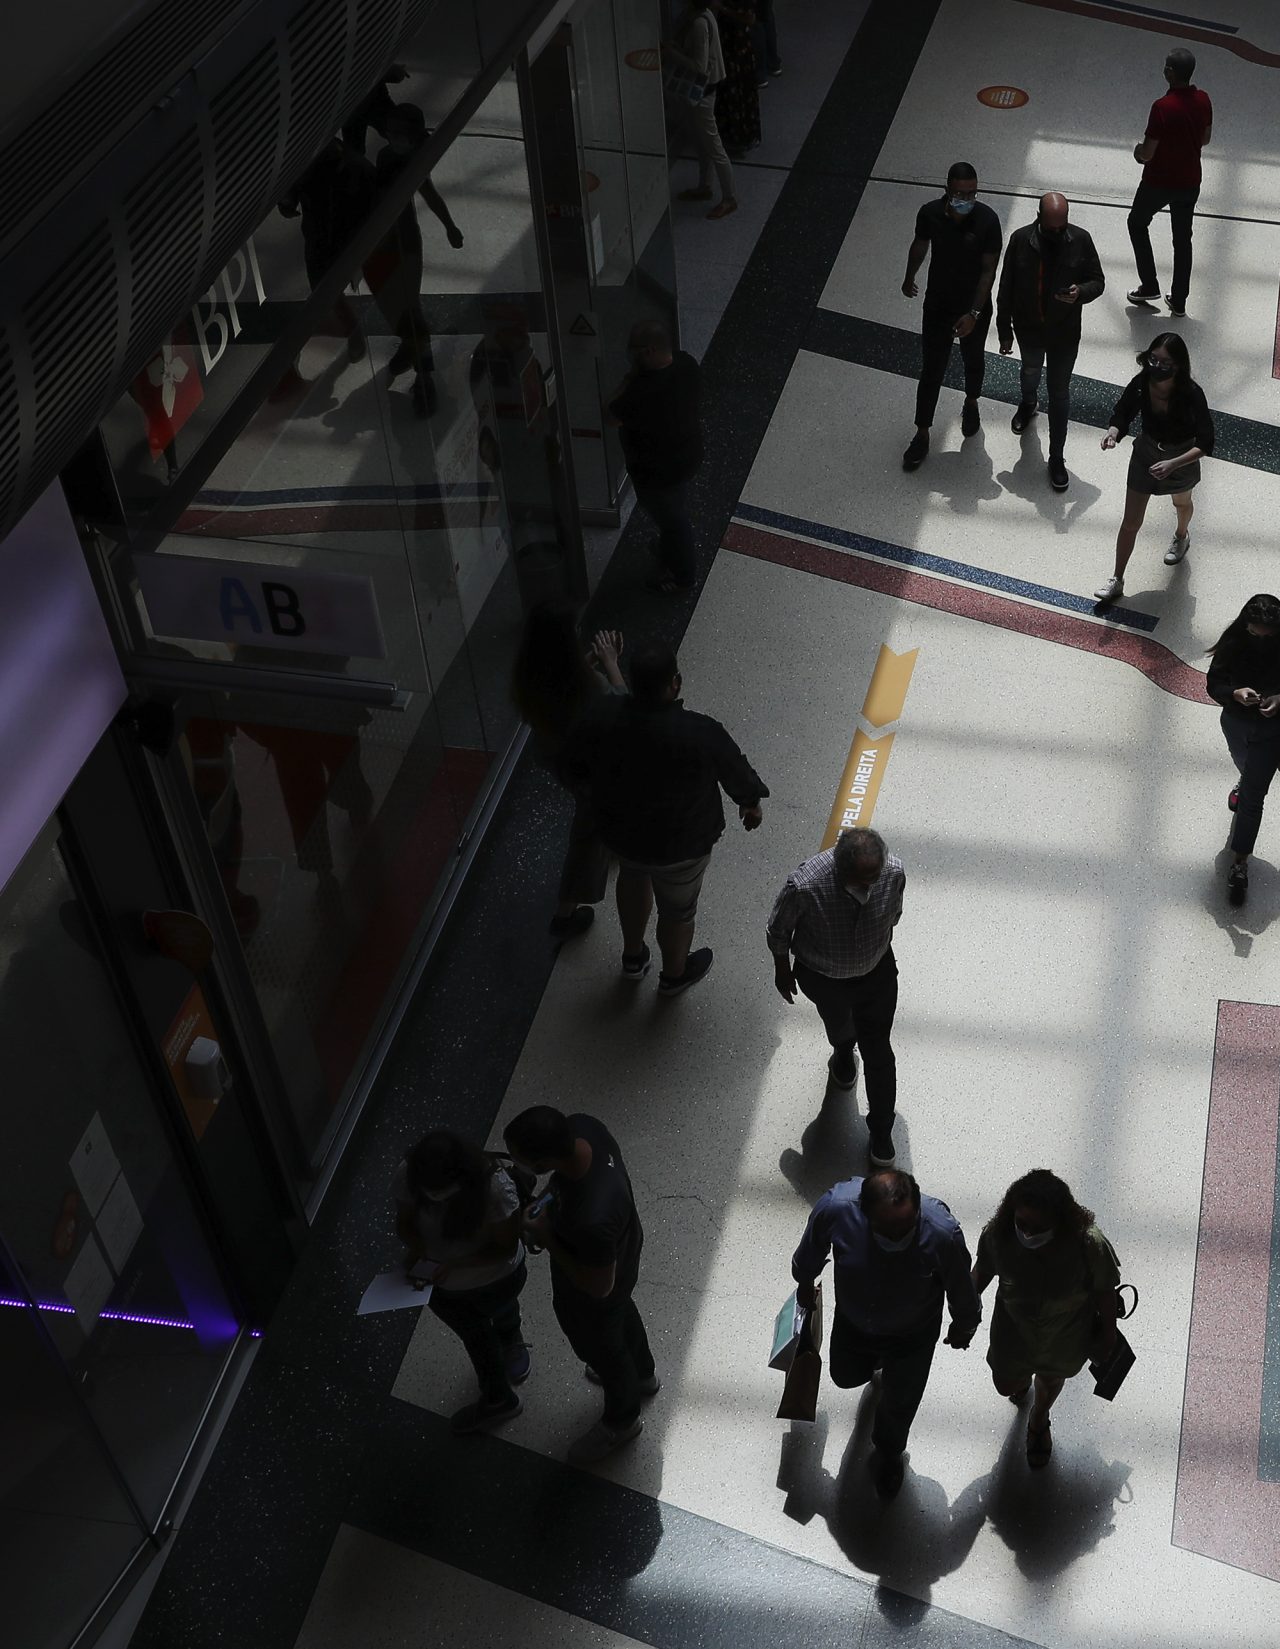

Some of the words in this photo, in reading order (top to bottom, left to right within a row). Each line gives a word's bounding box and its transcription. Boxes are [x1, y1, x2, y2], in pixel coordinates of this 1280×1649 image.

[191, 236, 267, 376] BPI
[219, 576, 306, 636] AB
[851, 749, 878, 795] DIREITA
[840, 797, 864, 828] PELA
